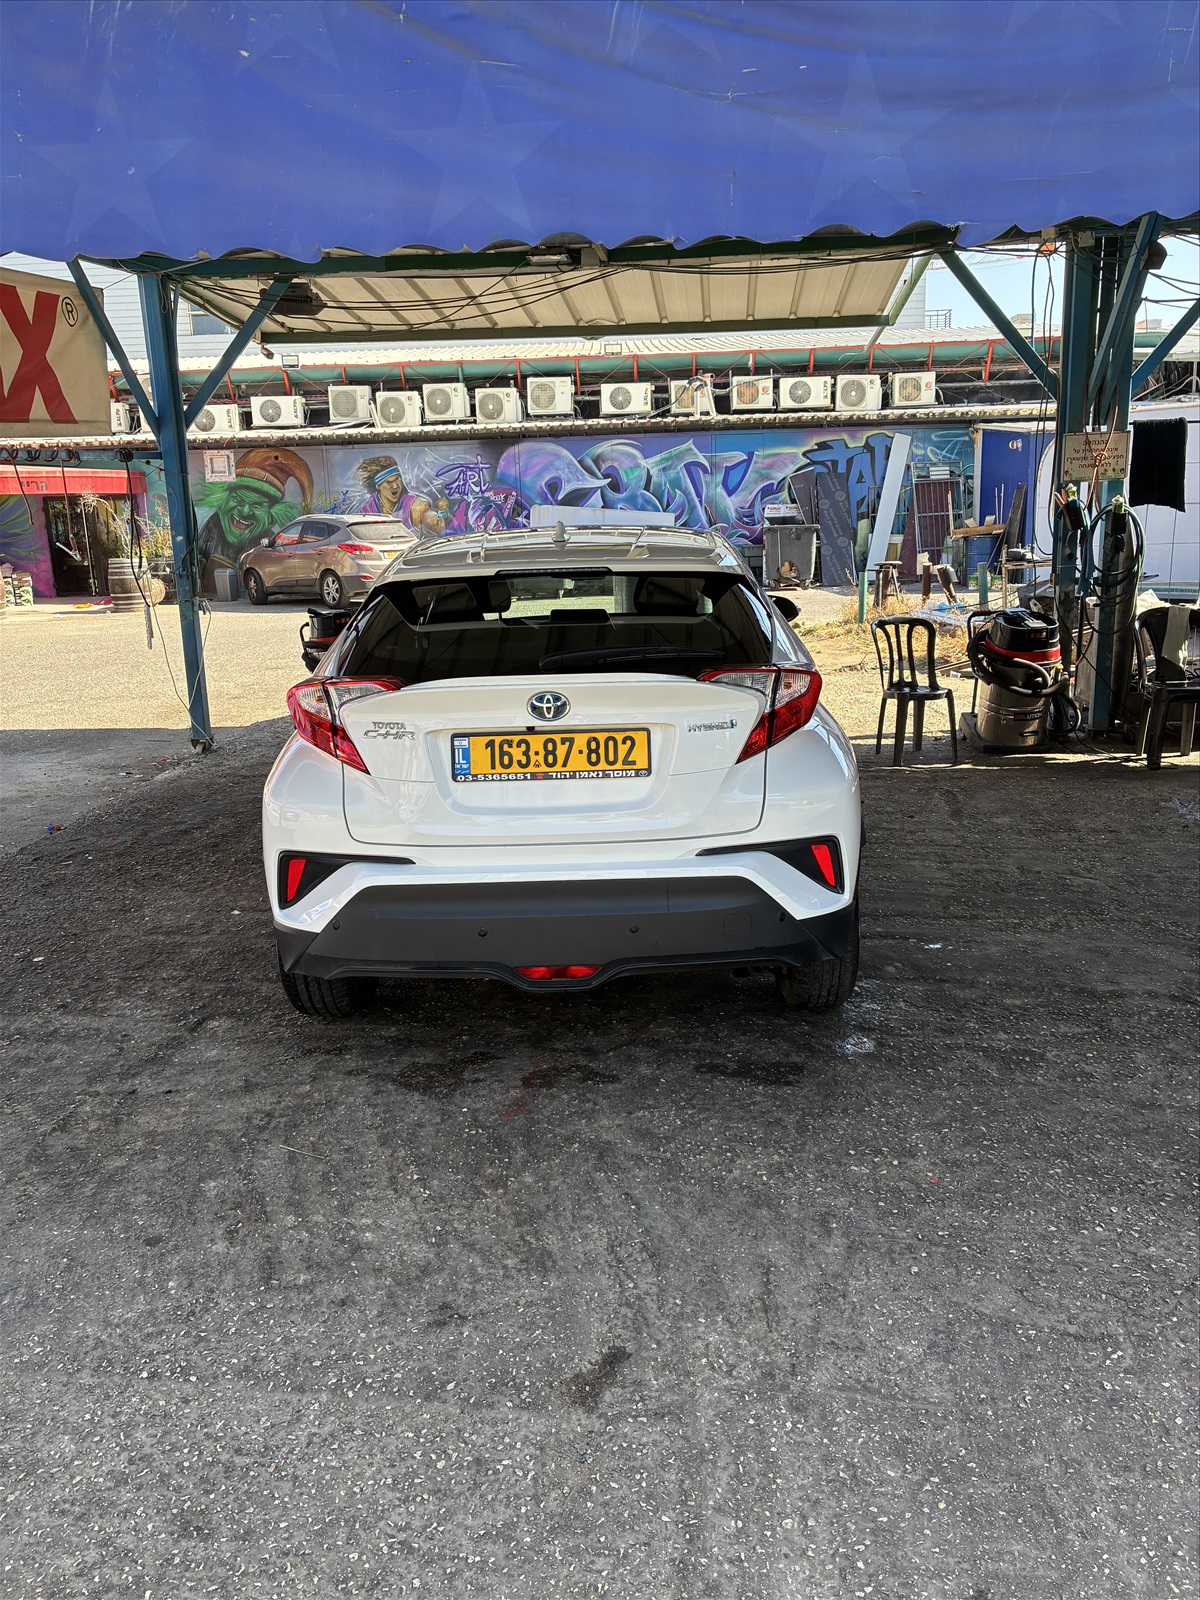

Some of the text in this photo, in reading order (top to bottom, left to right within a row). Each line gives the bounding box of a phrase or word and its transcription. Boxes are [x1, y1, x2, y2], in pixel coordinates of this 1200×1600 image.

[372, 721, 406, 730] TOYOTA
[363, 729, 416, 741] C-HR
[455, 748, 467, 764] IL
[457, 773, 531, 782] 03-5365651
[576, 771, 602, 779] נאמן
[606, 770, 635, 778] מוסך
